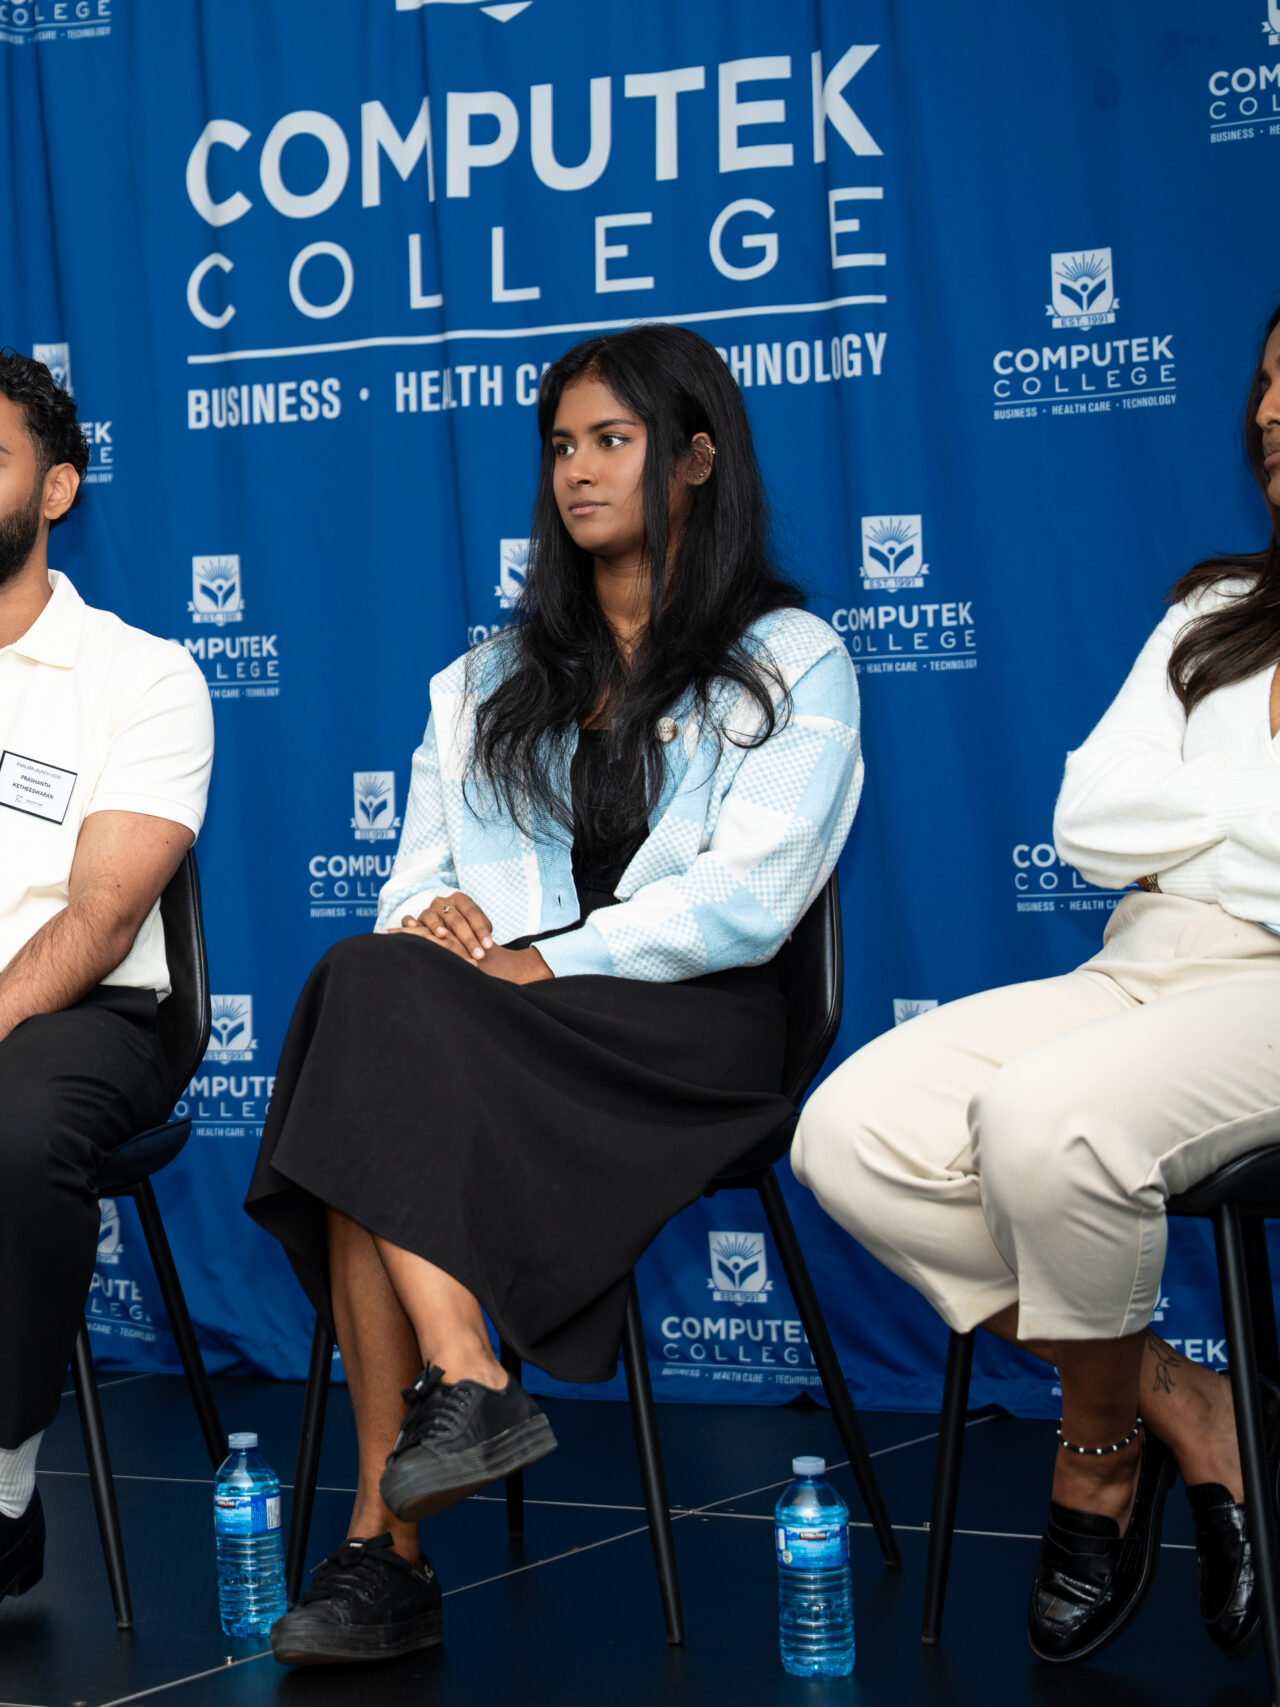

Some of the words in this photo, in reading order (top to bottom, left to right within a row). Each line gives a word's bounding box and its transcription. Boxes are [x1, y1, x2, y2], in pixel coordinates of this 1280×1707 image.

[186, 44, 884, 227] COMPUTEK
[1210, 127, 1256, 144] BUSINESS
[186, 187, 887, 329] COLLEGE
[993, 334, 1176, 375] COMPUTEK
[187, 377, 341, 430] BUSINESS
[715, 332, 888, 388] HNOLOGY
[993, 364, 1176, 398] COLLEGE
[993, 407, 1038, 420] BUSINESS
[1052, 402, 1086, 415] HEALTH
[1088, 401, 1111, 412] CARE
[1122, 394, 1177, 409] TECHNOLOGY
[831, 601, 975, 632] COMPUTEK
[169, 634, 279, 660] MPUTEK
[841, 629, 977, 654] OLLEGE
[216, 660, 280, 680] LEGE
[895, 661, 918, 673] CARE
[308, 854, 398, 879] COMPU
[309, 880, 379, 898] COLL
[1017, 901, 1055, 913] BUSINESS
[1069, 900, 1104, 911] HEALTH
[182, 1075, 276, 1098] MPUTE
[174, 1101, 271, 1118] OLLE
[196, 1127, 223, 1137] HEALTH
[225, 1127, 245, 1137] CARE
[89, 1273, 142, 1301] PUTE
[661, 1316, 808, 1343] COMPUTE
[663, 1343, 816, 1365] COLLEG
[712, 1371, 741, 1383] HEALTH
[742, 1374, 763, 1384] CARE
